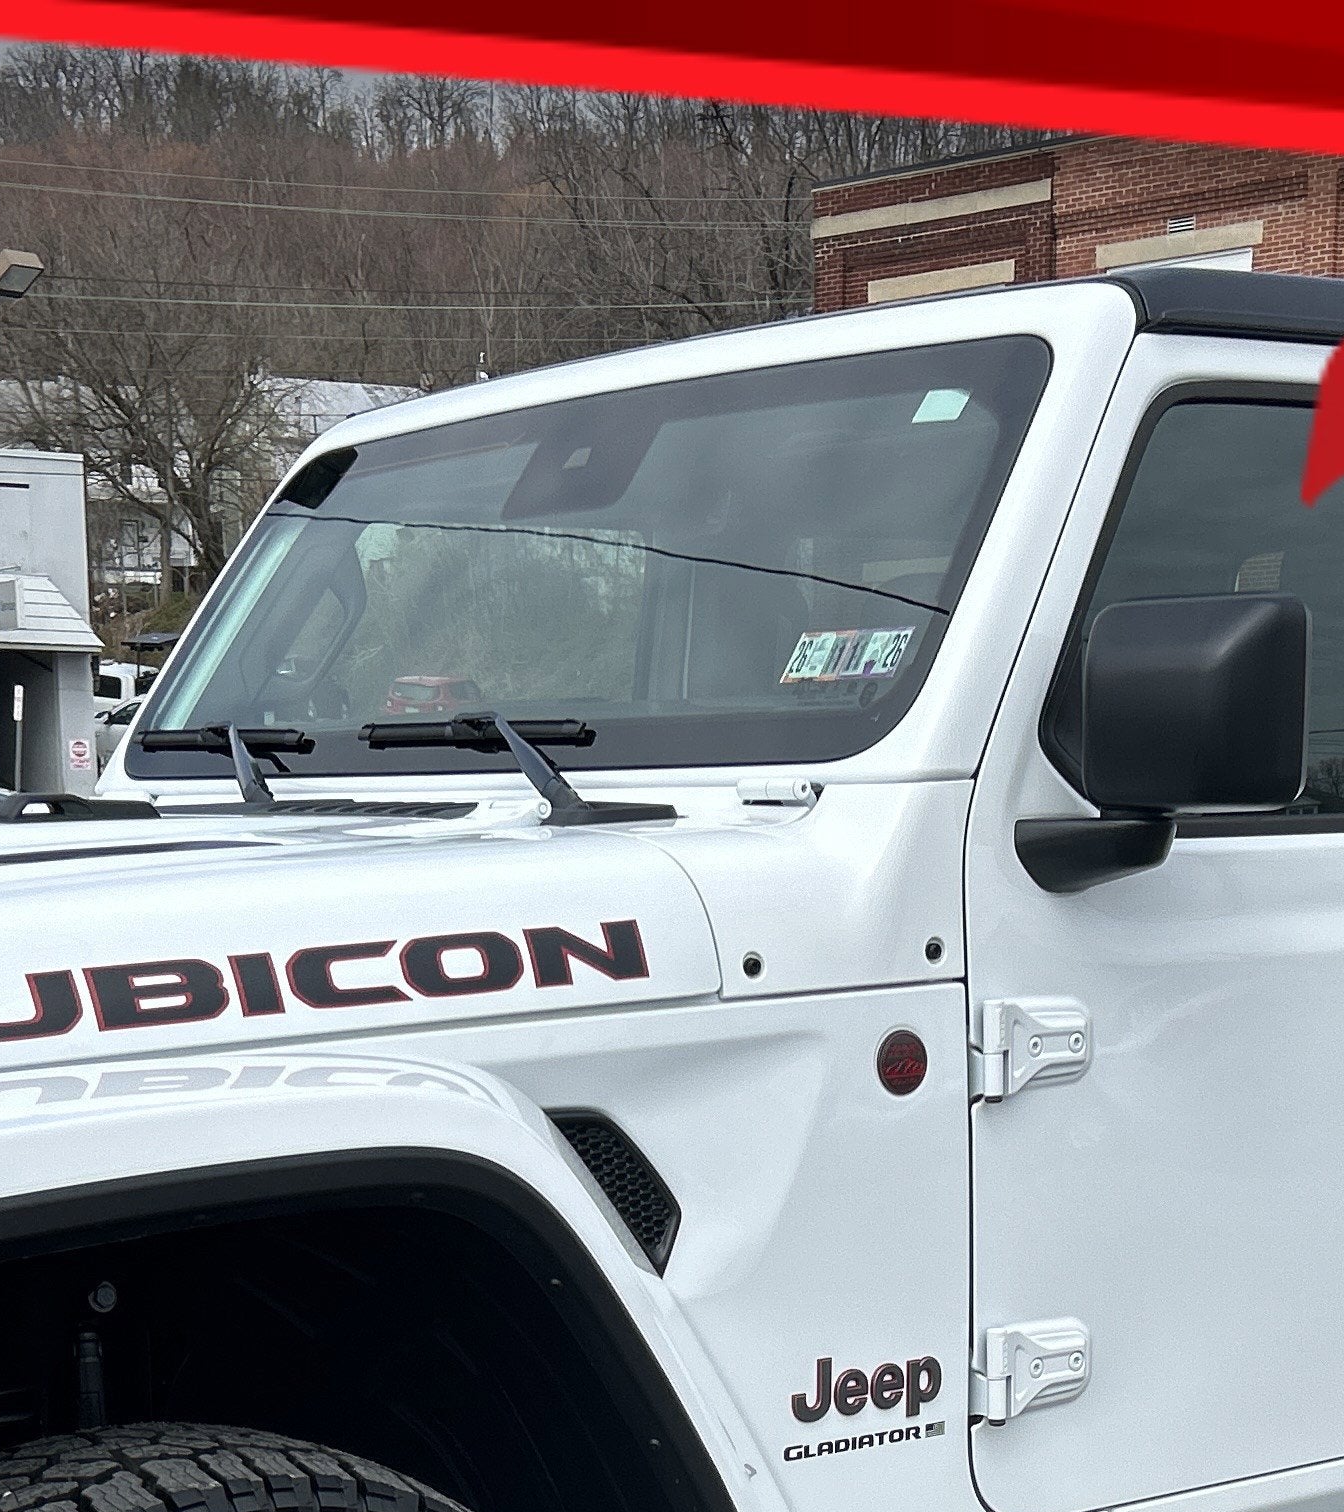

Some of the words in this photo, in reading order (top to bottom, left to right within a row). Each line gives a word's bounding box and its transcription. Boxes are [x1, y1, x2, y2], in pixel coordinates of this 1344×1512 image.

[881, 633, 909, 669] 26
[791, 1355, 942, 1423] Jeep
[783, 1425, 922, 1462] GLADIATOR
